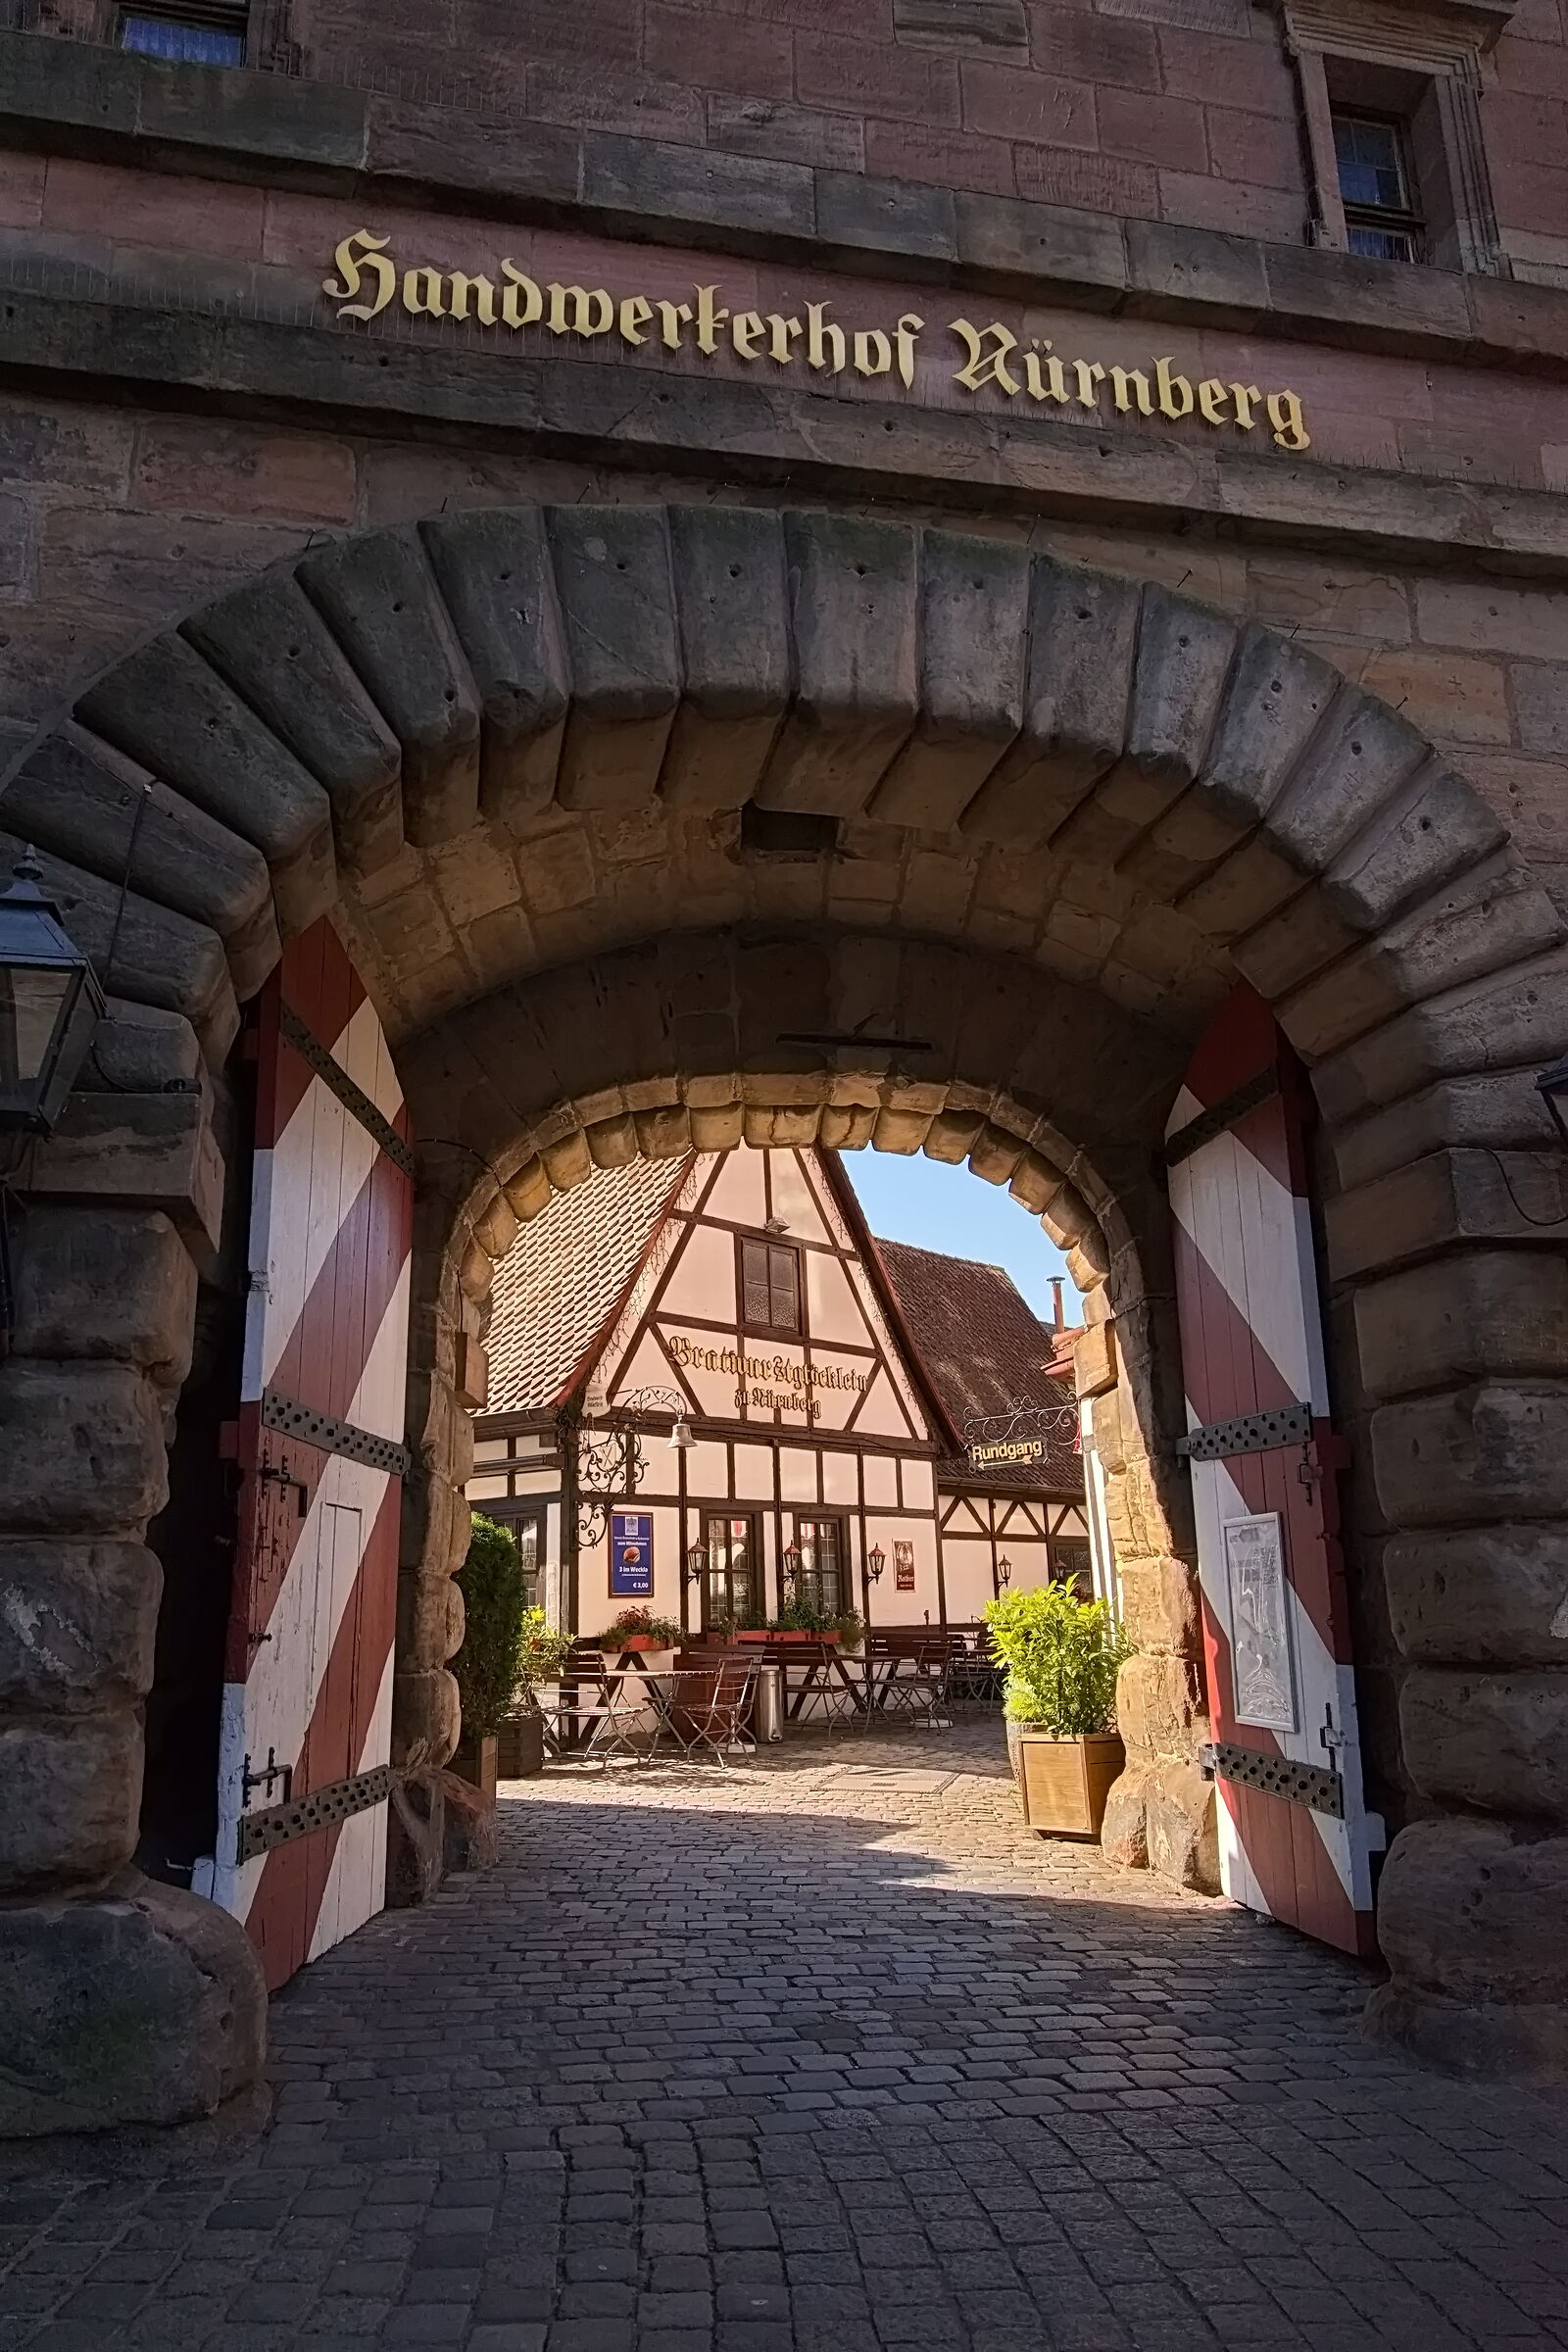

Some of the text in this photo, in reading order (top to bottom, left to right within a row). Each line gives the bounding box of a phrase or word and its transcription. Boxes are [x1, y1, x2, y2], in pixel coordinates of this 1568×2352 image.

[321, 228, 1311, 451] Handwerkerhof Nürnberg
[735, 1387, 822, 1419] zu Nürnberg
[972, 1441, 1043, 1461] Rundgang
